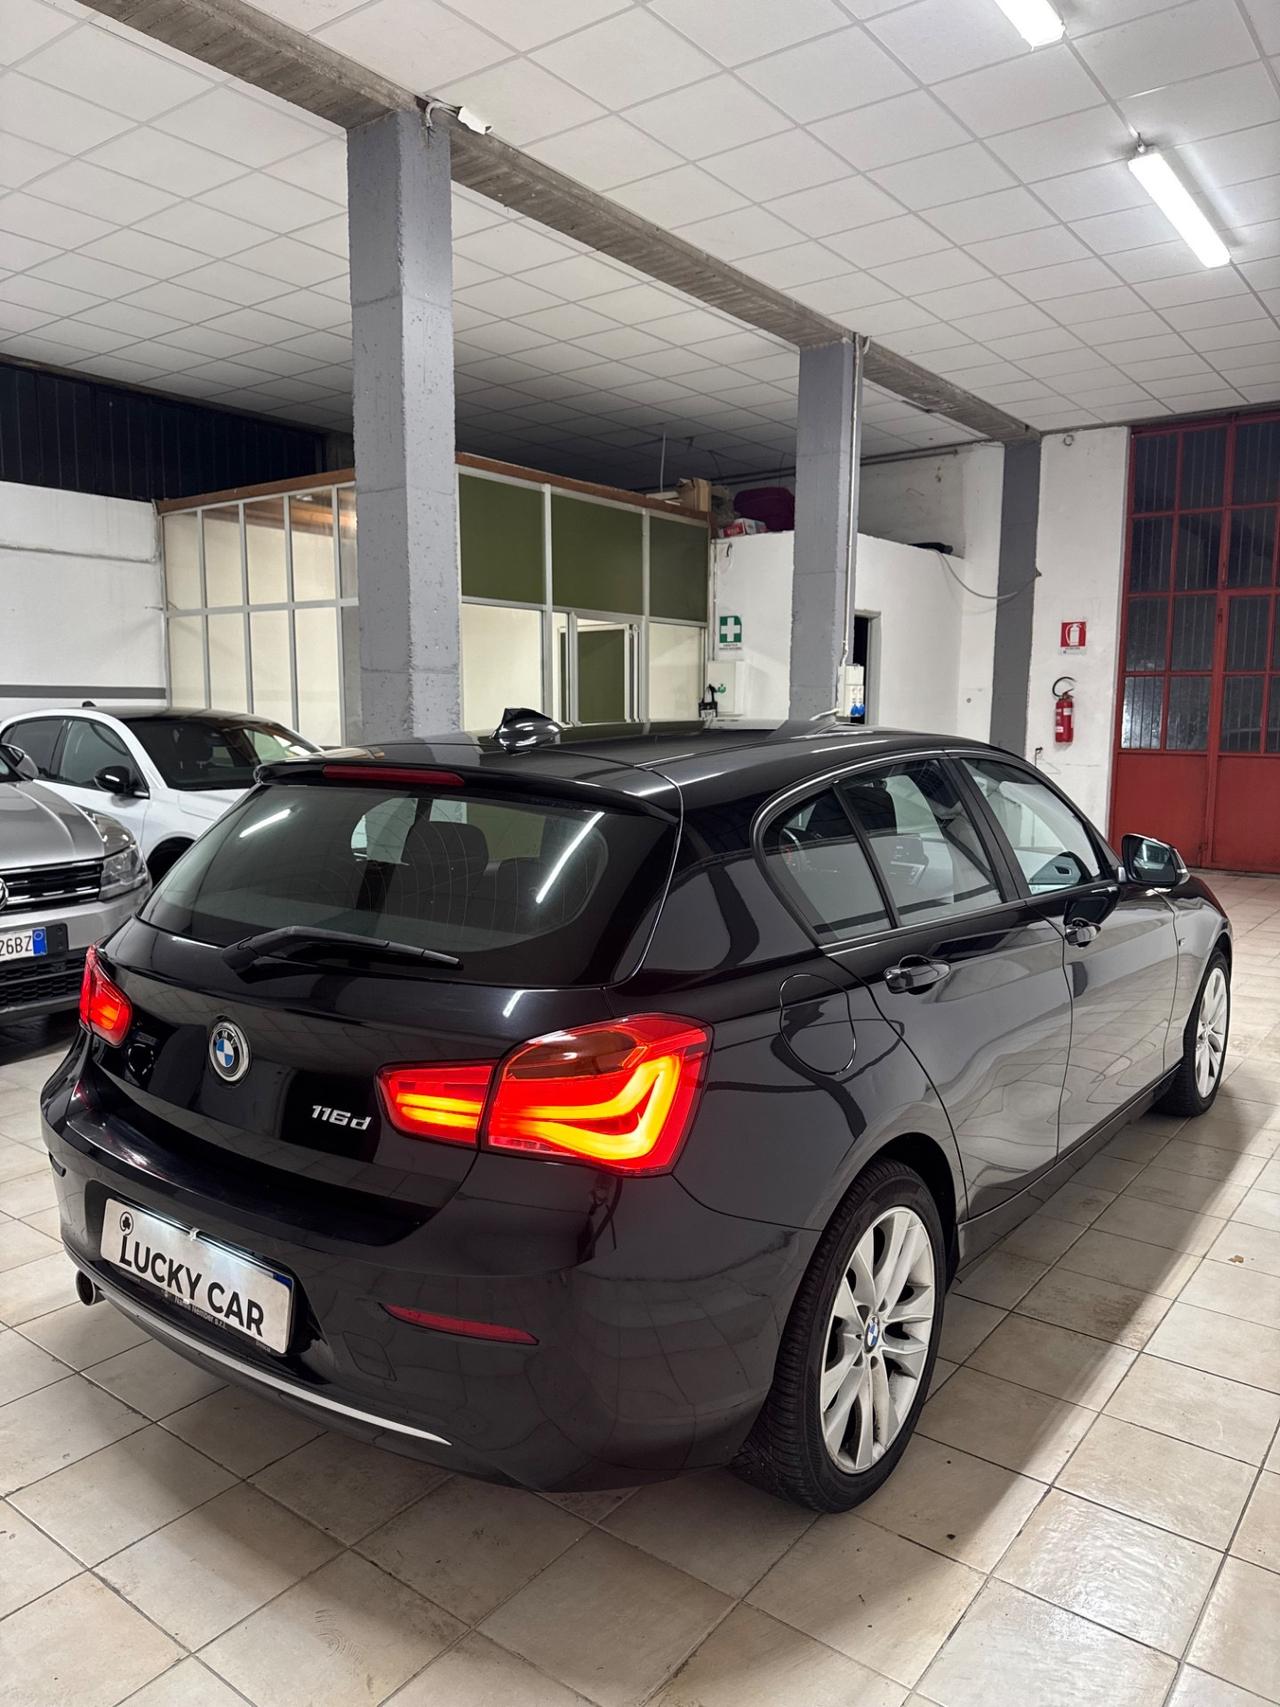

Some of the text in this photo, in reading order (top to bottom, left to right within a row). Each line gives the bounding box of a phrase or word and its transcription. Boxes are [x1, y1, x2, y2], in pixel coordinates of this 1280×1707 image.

[0, 935, 33, 957] 26BZ
[311, 1104, 372, 1131] 116d
[119, 1234, 265, 1337] LUCKY CAR
